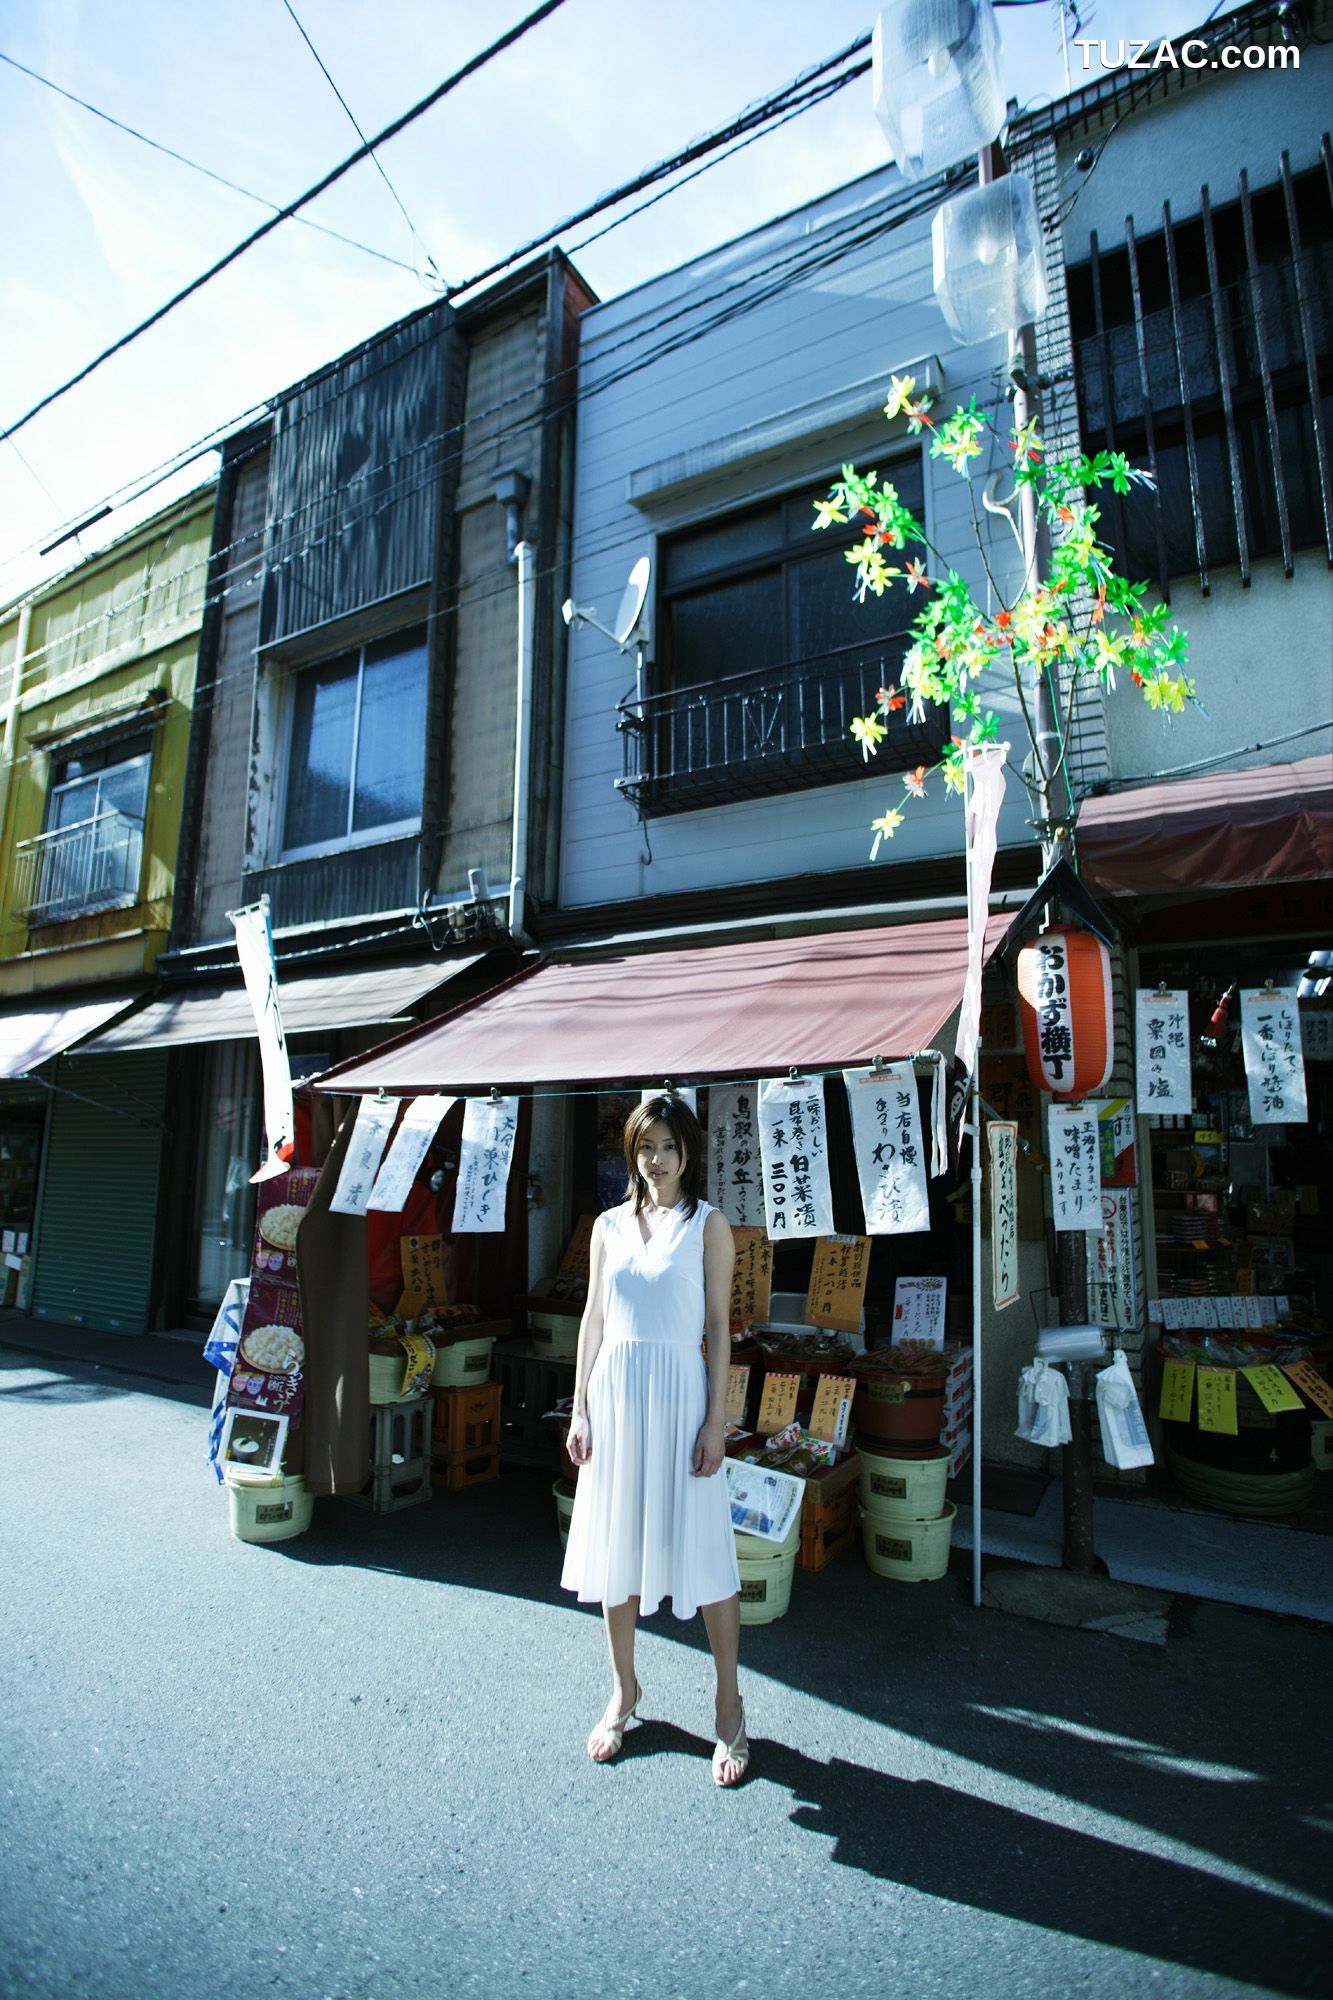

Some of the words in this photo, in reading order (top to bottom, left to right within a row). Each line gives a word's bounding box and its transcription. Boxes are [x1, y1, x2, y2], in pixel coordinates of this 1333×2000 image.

[1037, 945, 1072, 1080] おかず横丁
[1167, 1013, 1185, 1049] 沖縄
[1148, 1018, 1173, 1098] 粟国の塩
[895, 1091, 917, 1167] 当店自慢
[1055, 1157, 1068, 1217] あります
[1063, 1125, 1084, 1215] 味噌たまり
